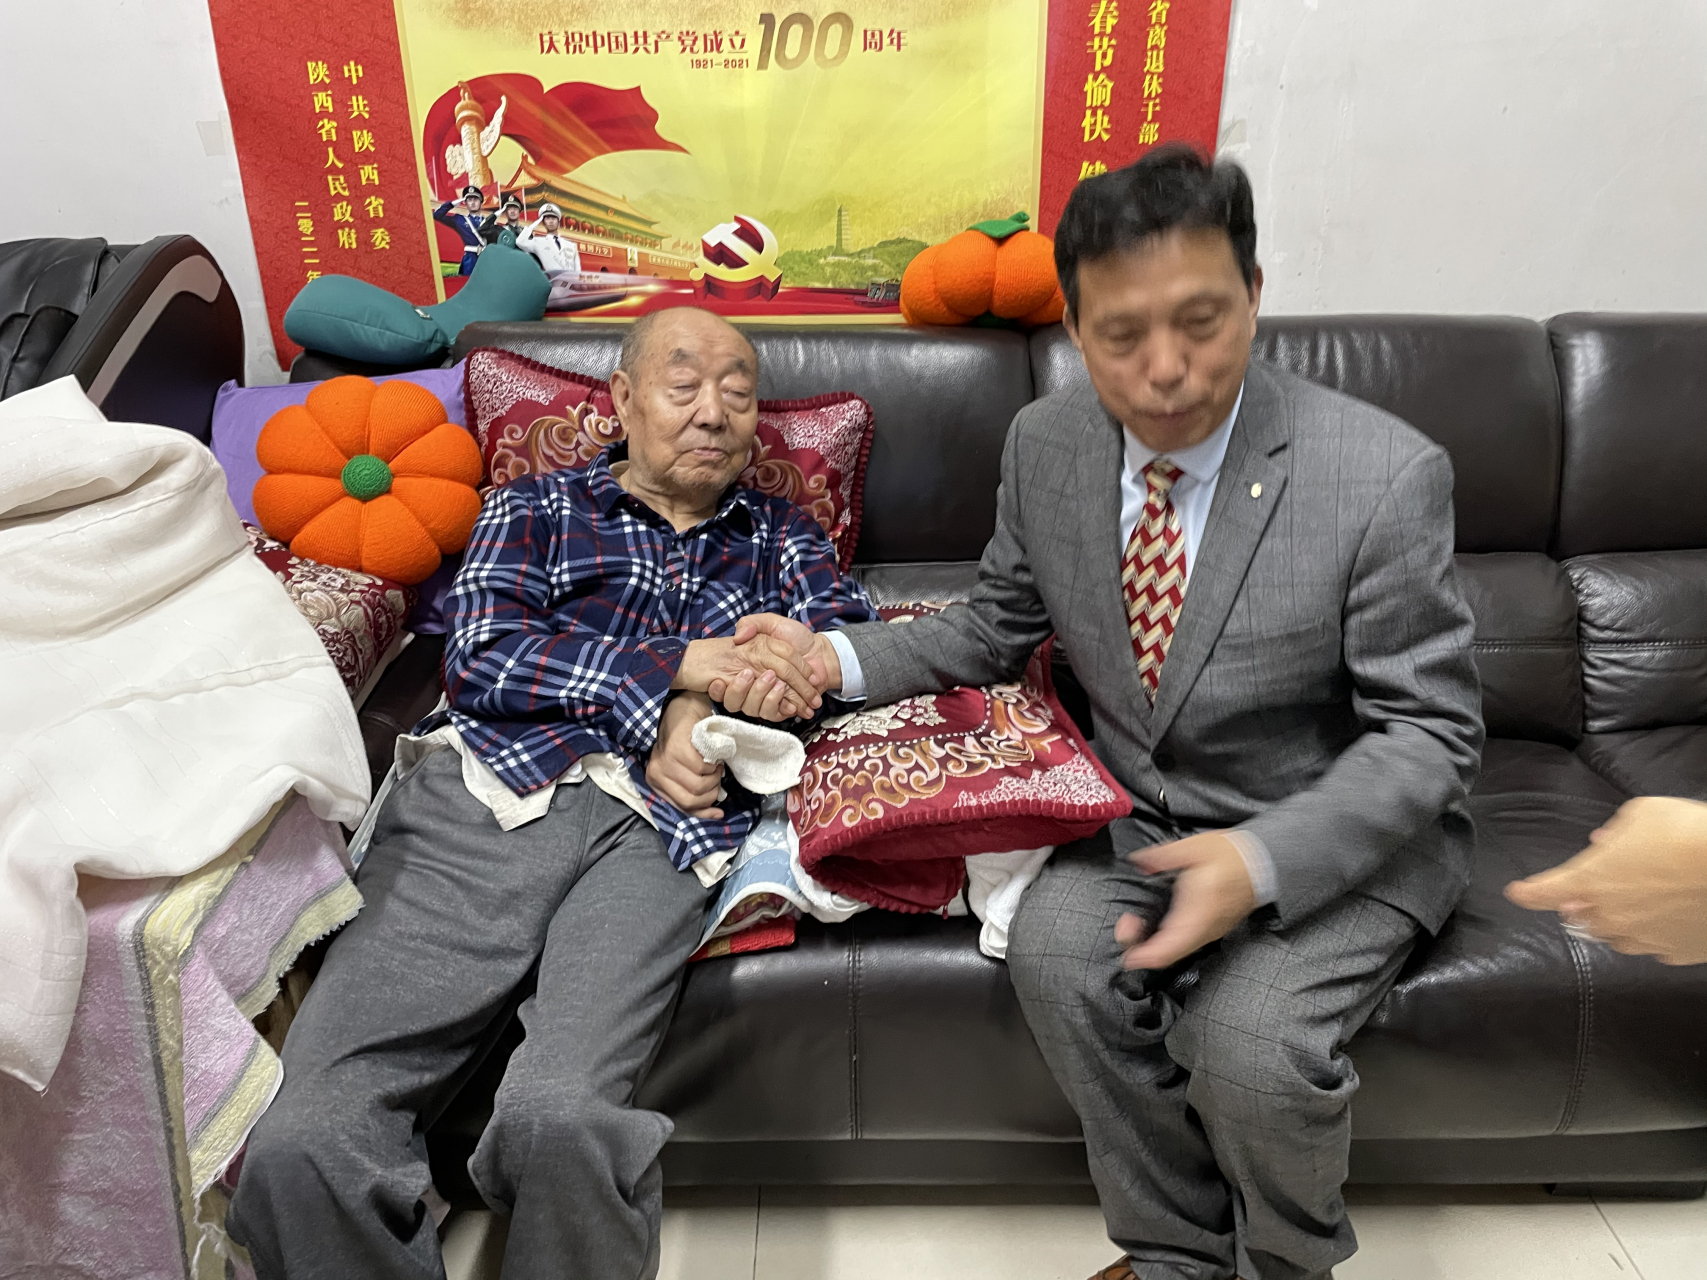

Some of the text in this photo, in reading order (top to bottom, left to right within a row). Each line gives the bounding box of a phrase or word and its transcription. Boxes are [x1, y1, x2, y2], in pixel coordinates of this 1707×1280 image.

[690, 58, 750, 70] 1921-2021
[756, 12, 854, 71] 100
[1081, 0, 1119, 142] 春节愉快
[1138, 0, 1170, 145] 省离退休干部
[307, 61, 357, 250] 陕西省人民政府
[343, 60, 390, 250] 中共陕西省委
